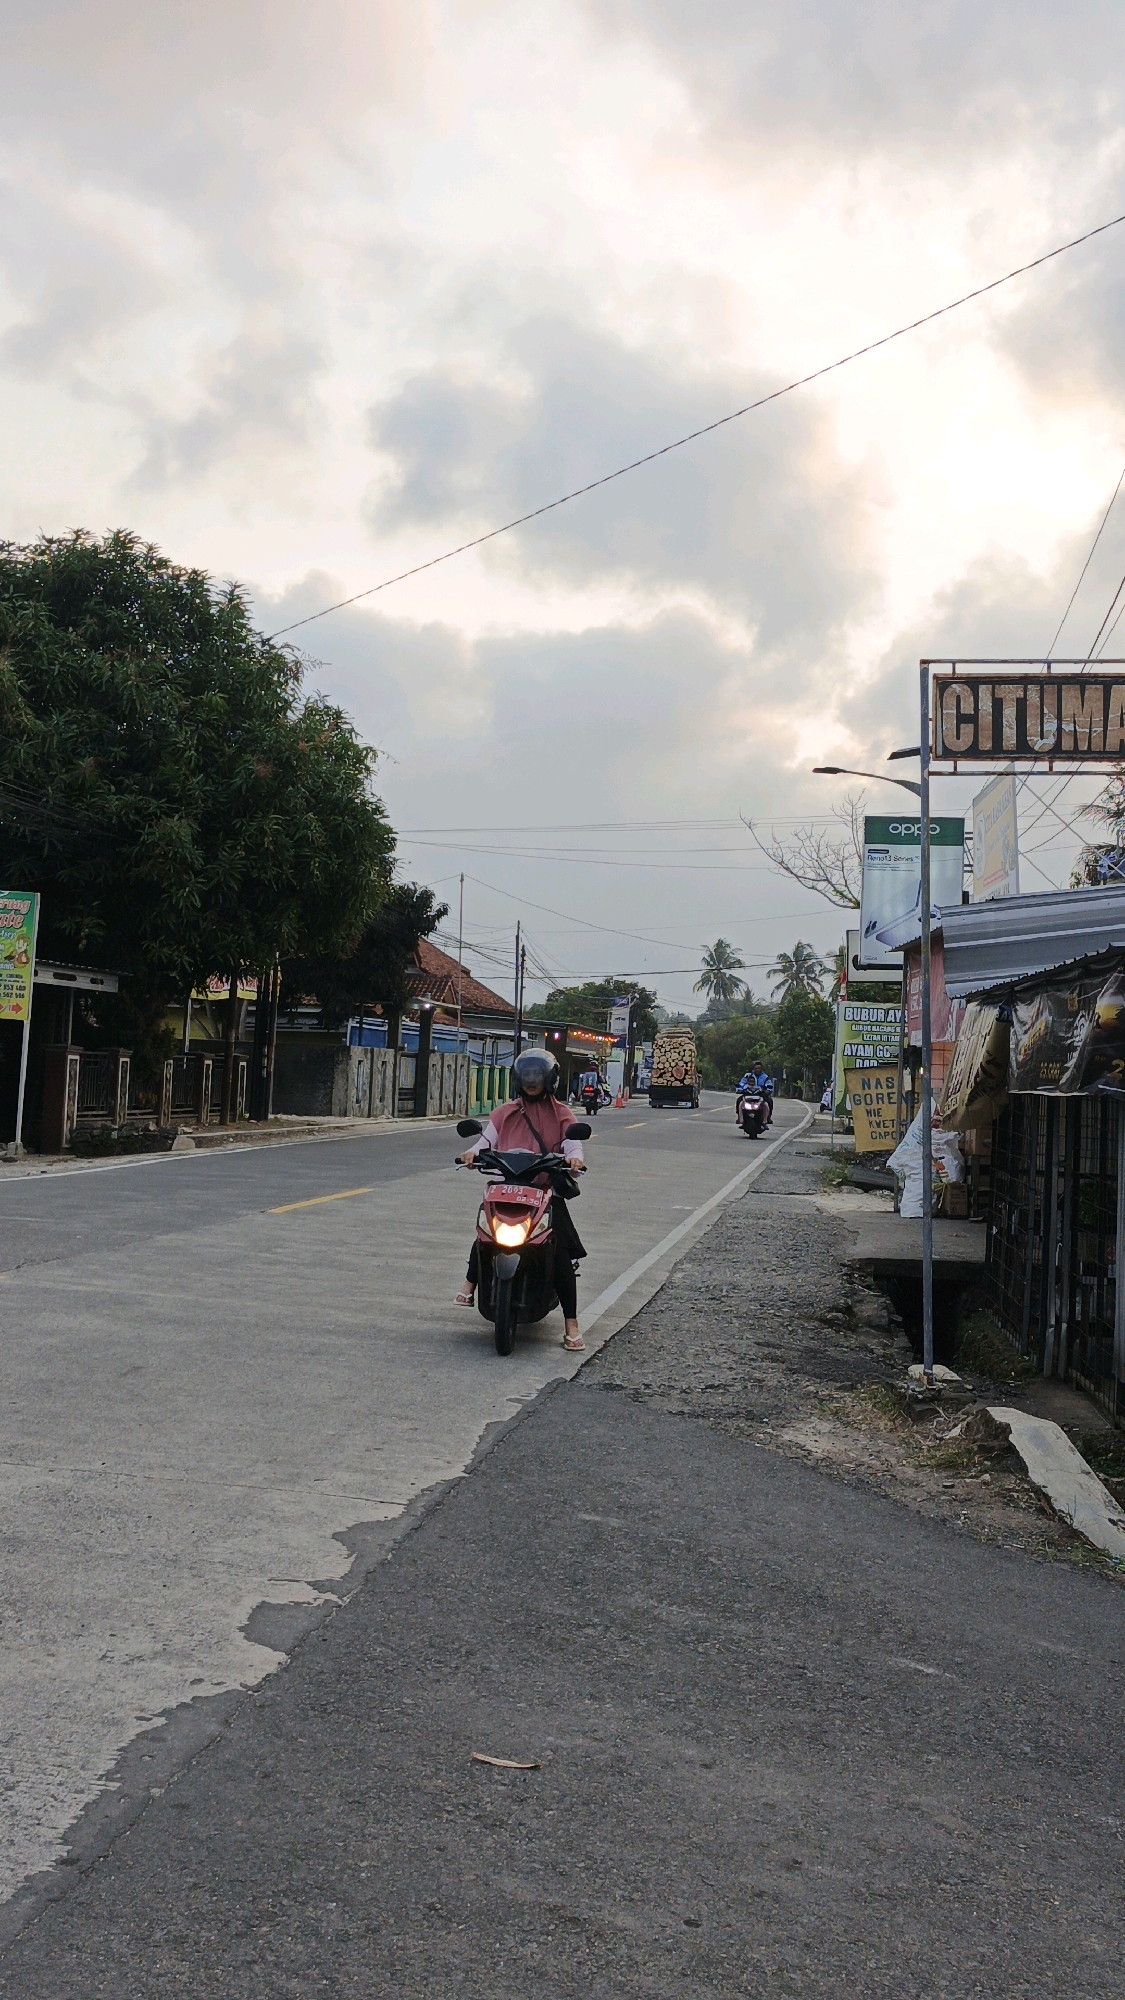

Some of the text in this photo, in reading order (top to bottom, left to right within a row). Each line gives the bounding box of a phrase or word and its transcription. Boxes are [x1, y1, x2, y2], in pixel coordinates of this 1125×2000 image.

[888, 823, 940, 837] oppo
[845, 1007, 885, 1022] BUBUR
[844, 1044, 874, 1057] AYAM
[862, 1077, 895, 1090] NAS
